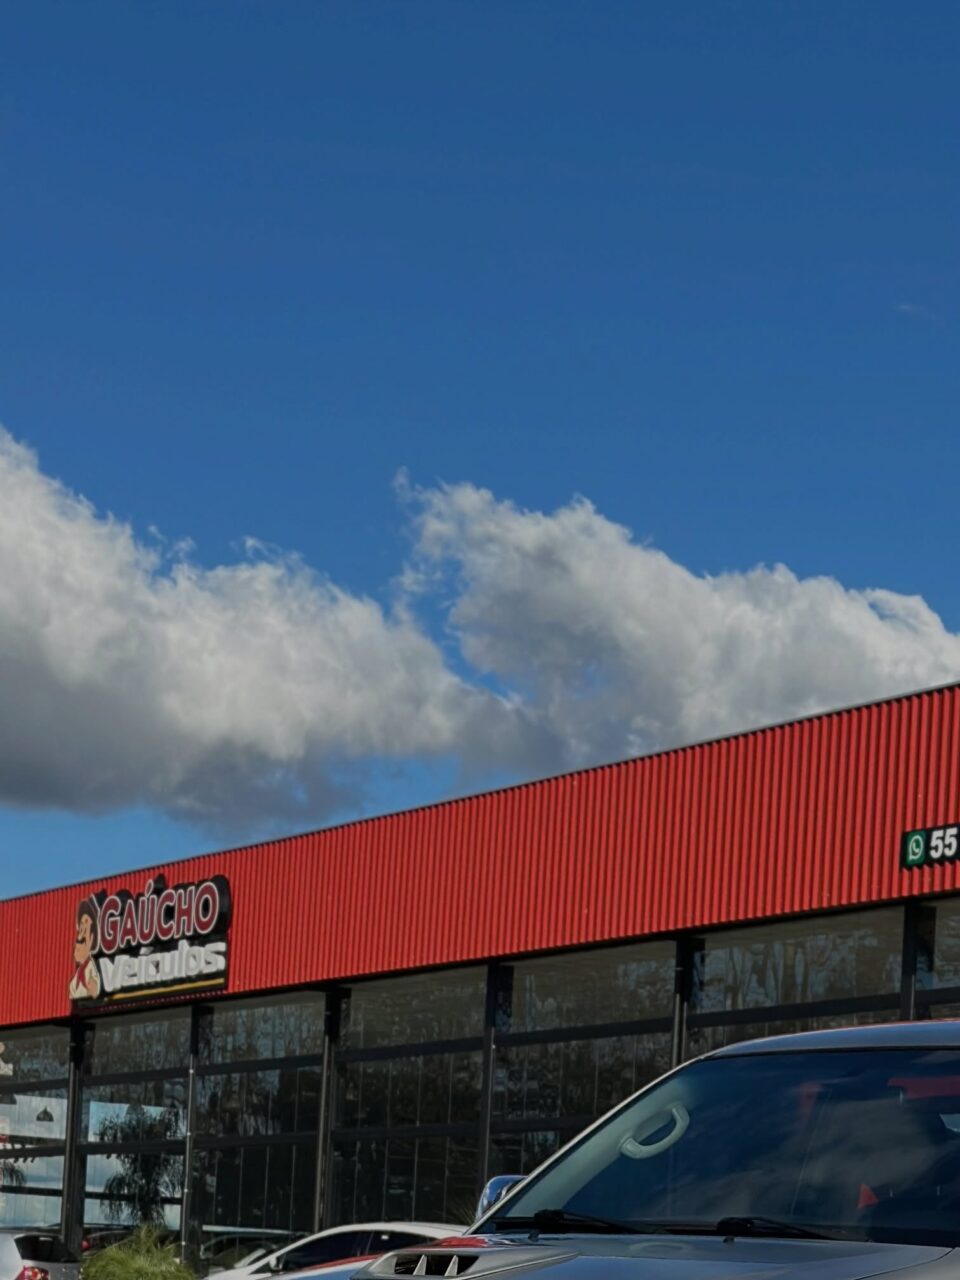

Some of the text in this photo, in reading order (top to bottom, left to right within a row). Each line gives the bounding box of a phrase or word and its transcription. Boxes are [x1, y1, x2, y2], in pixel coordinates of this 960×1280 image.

[930, 827, 957, 858] 55
[99, 880, 219, 953] GAÚCHO
[100, 940, 226, 992] Veículos
